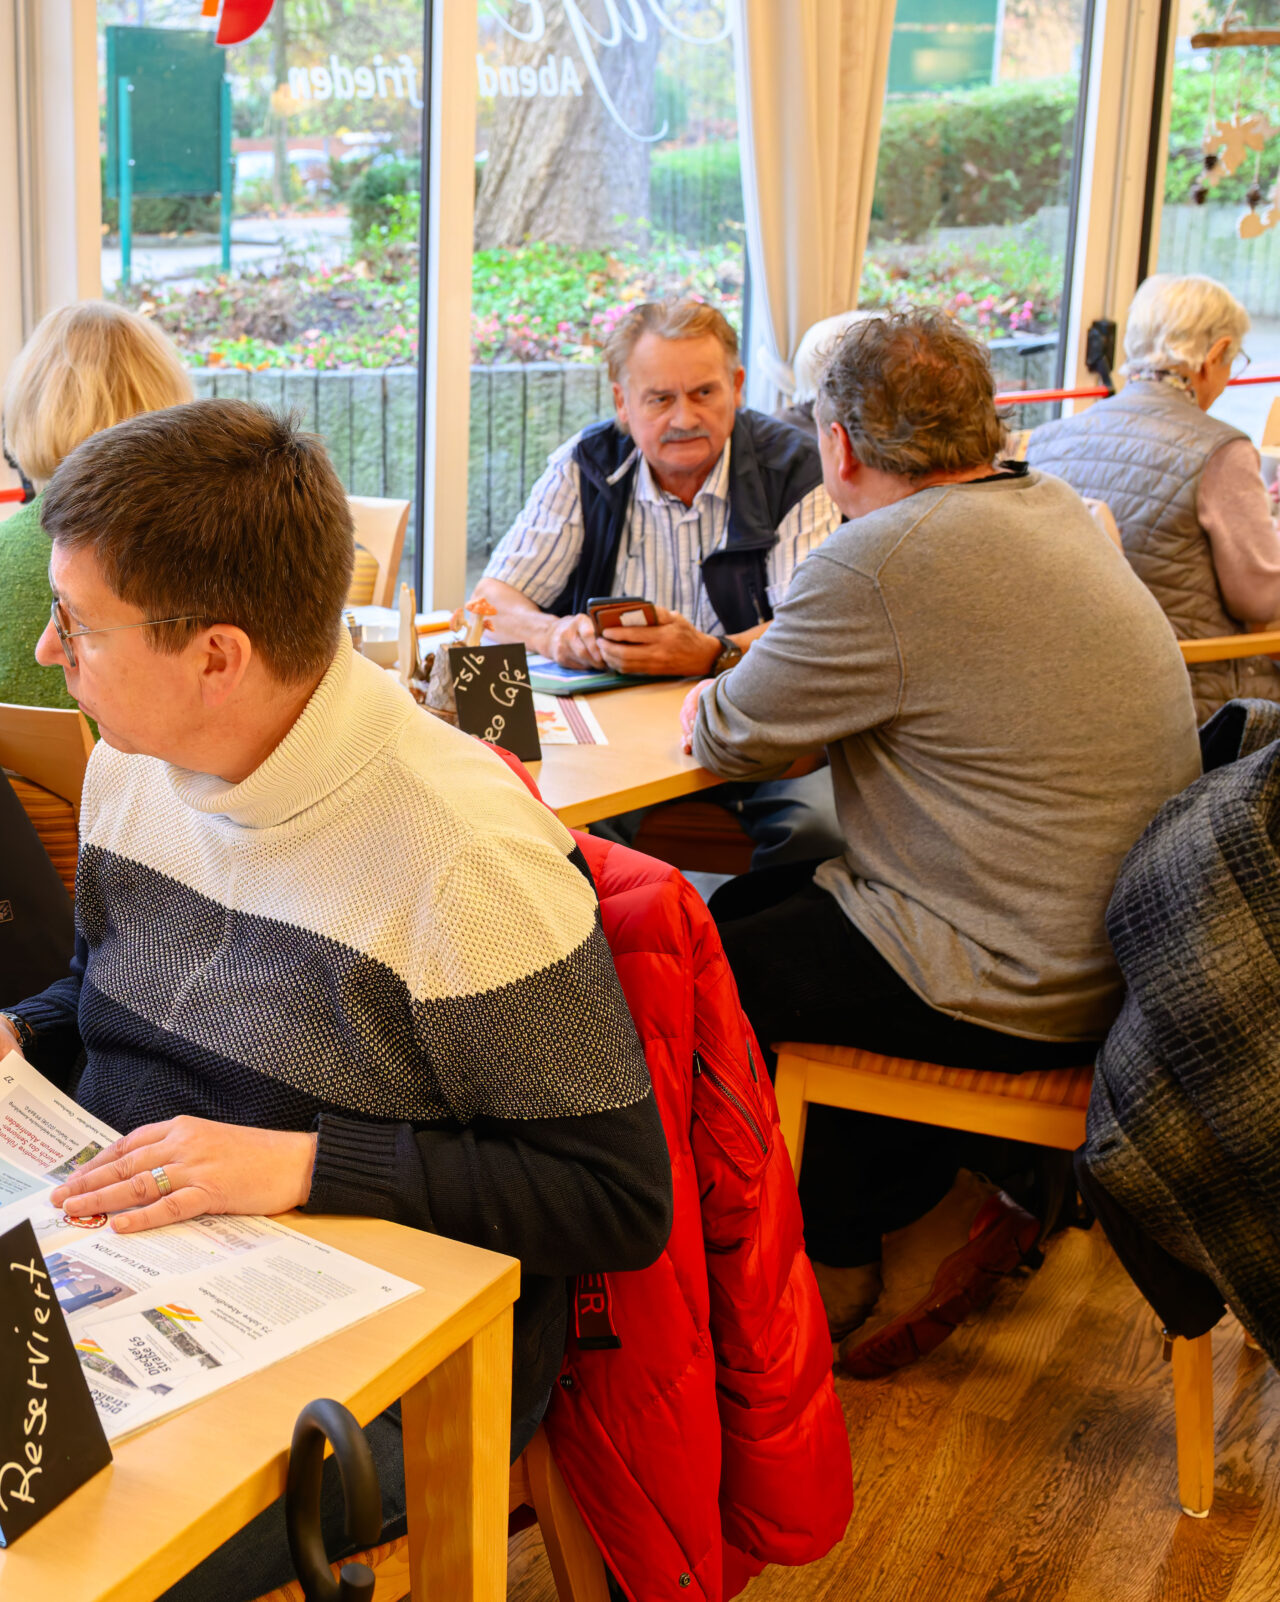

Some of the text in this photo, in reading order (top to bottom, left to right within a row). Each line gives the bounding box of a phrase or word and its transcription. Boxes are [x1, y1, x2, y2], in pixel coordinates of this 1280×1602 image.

[3, 1075, 15, 1084] 27
[19, 1145, 50, 1169] Informative
[28, 1143, 40, 1153] das
[39, 1150, 57, 1164] durch
[40, 1140, 64, 1159] zentrum
[91, 1243, 160, 1277] GRATULATION
[129, 1336, 145, 1347] 65
[128, 1347, 161, 1376] Diecker
[143, 1347, 172, 1373] straße
